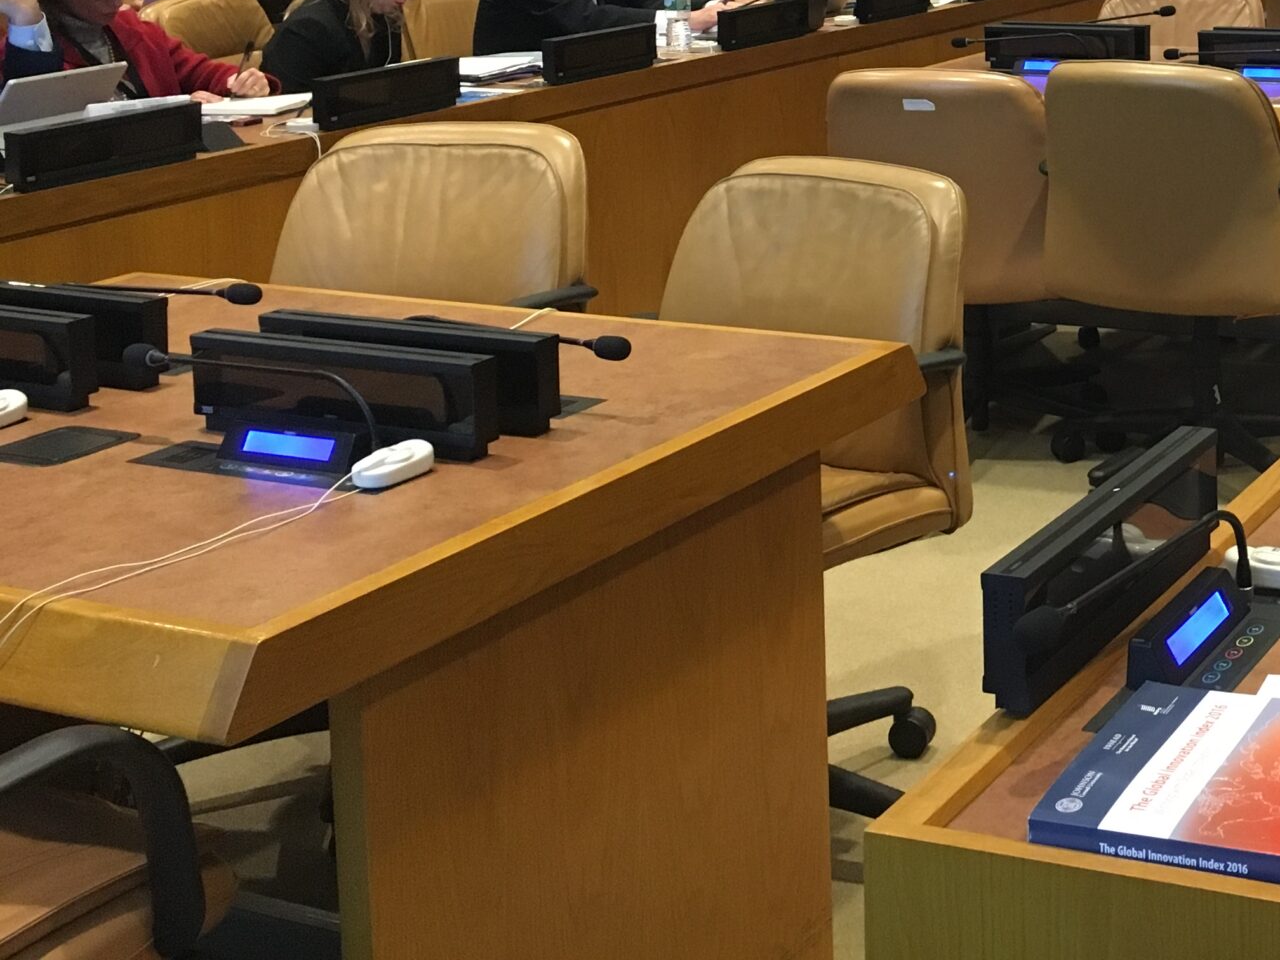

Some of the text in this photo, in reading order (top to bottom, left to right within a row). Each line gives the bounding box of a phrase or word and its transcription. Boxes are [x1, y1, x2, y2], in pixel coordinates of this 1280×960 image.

[1129, 797, 1152, 811] The
[1142, 772, 1170, 797] Global
[1160, 738, 1199, 774] Innovation
[1190, 720, 1215, 741] Index
[1205, 704, 1228, 721] 2016
[1099, 842, 1249, 875] The Global Innovation Index 2016
